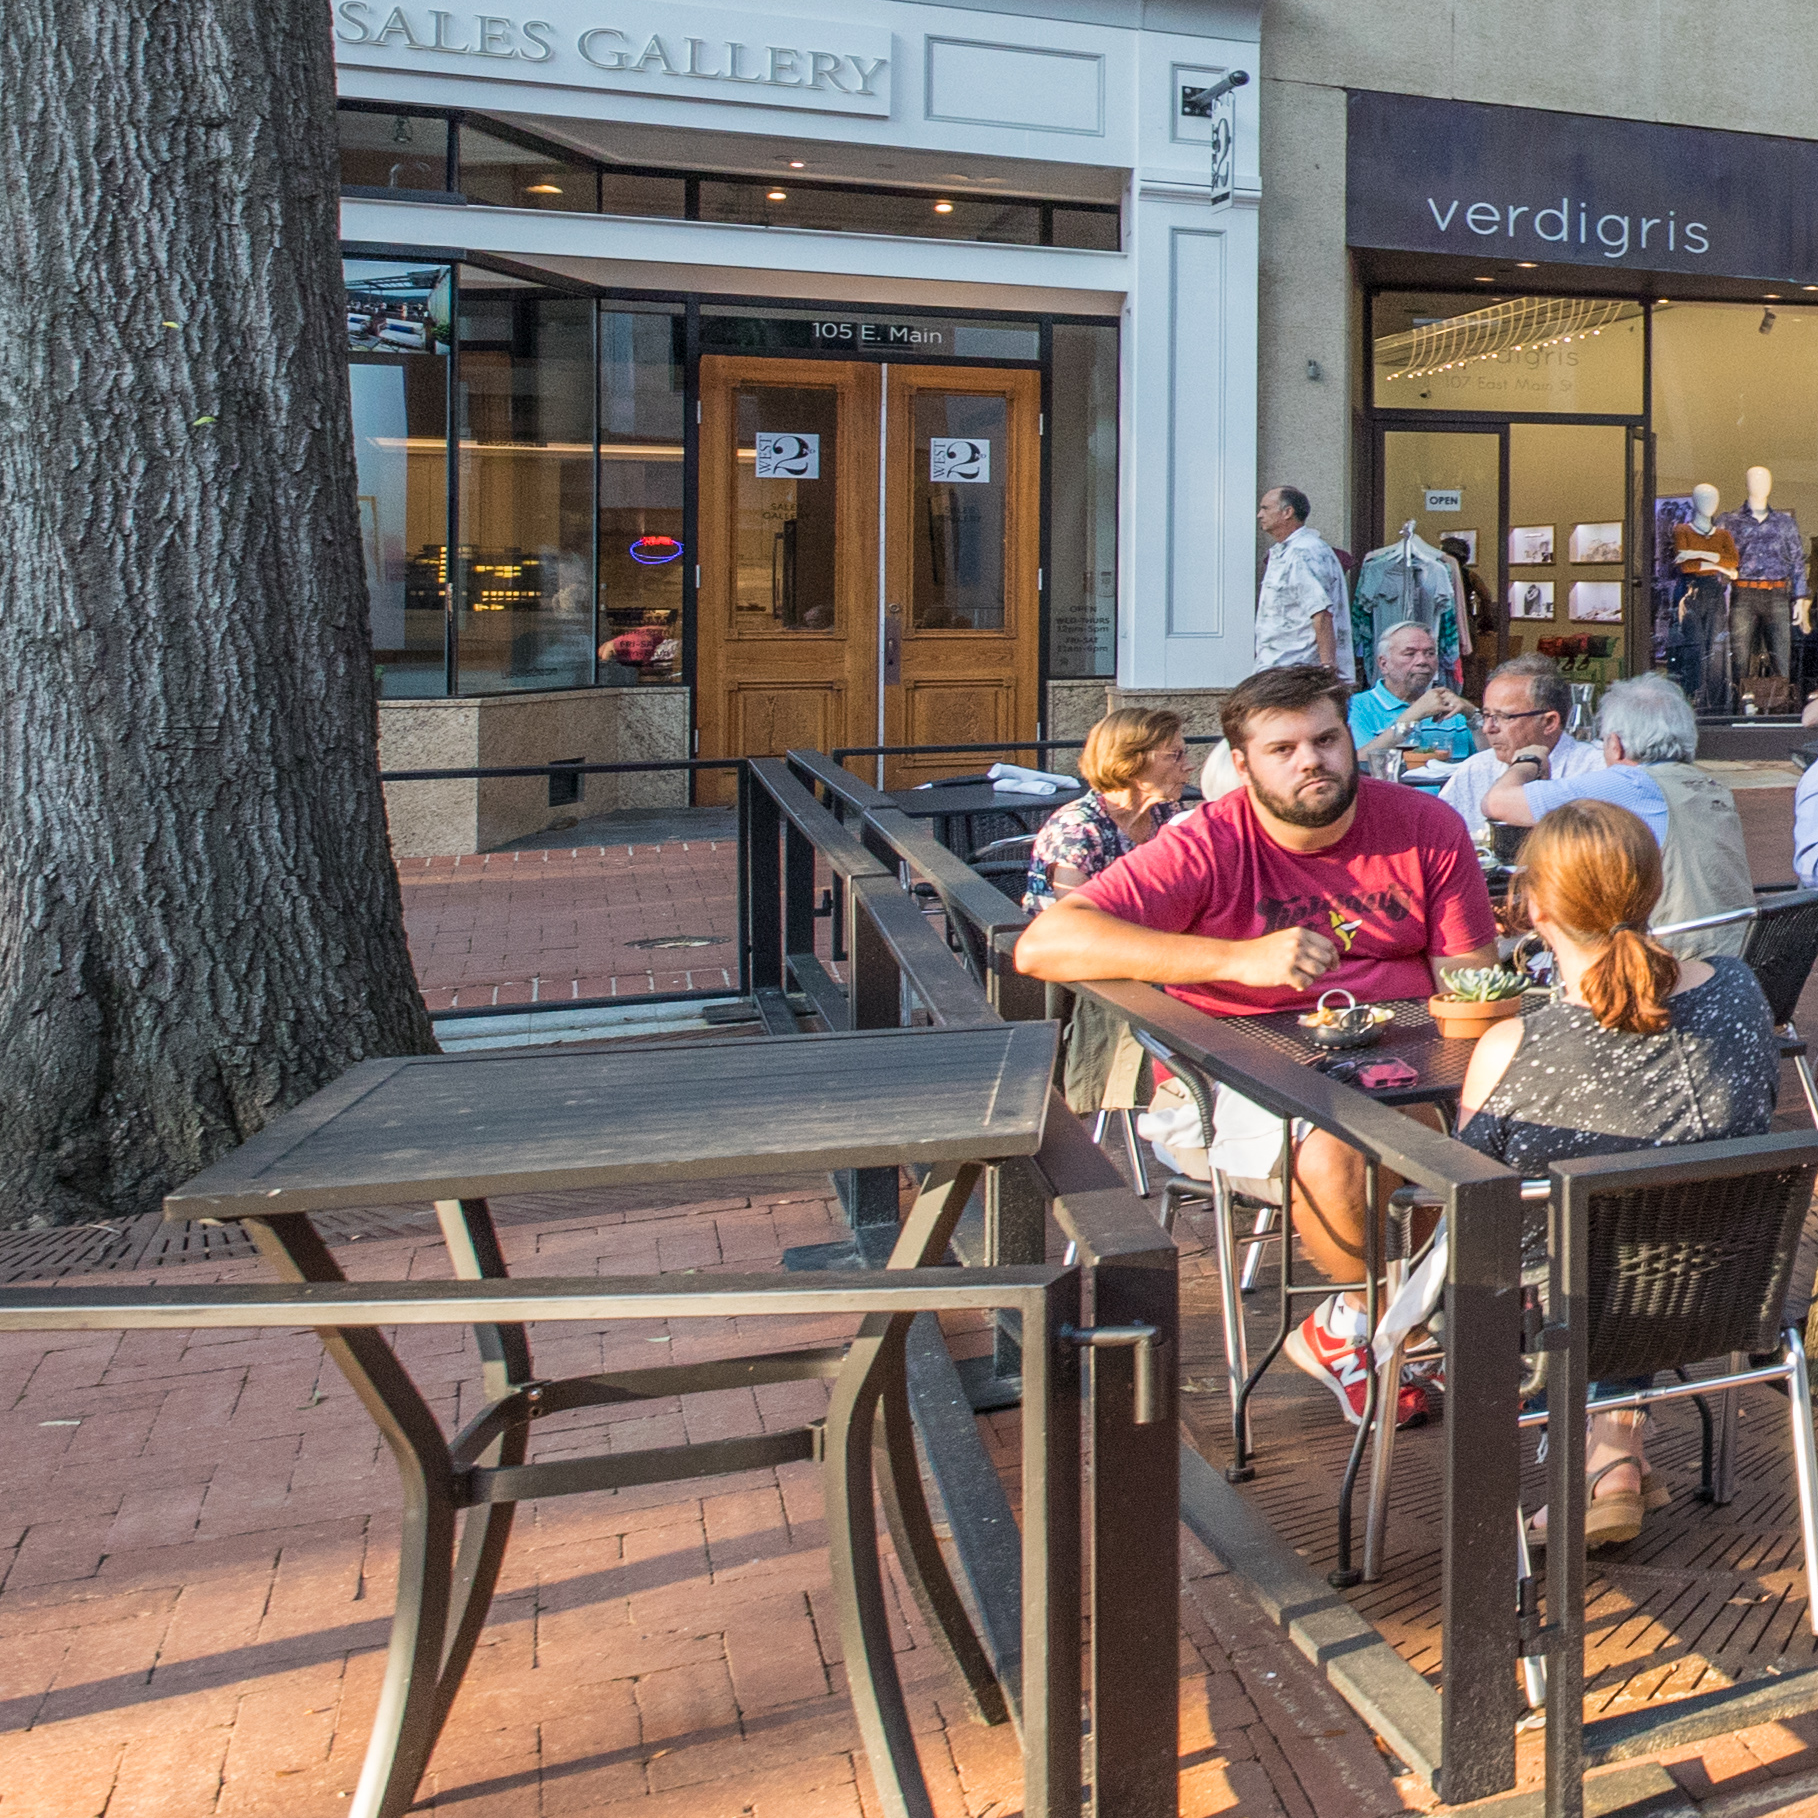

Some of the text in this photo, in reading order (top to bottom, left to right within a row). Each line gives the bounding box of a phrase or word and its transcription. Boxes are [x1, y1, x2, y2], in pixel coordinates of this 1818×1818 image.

[335, 0, 889, 95] SALES GALLERY
[1428, 197, 1710, 258] verdigris
[812, 322, 942, 344] 105 E. Main
[758, 435, 773, 475] WEST
[932, 440, 946, 478] WEST
[1429, 495, 1459, 506] OPEN
[1069, 605, 1097, 613] OPEN
